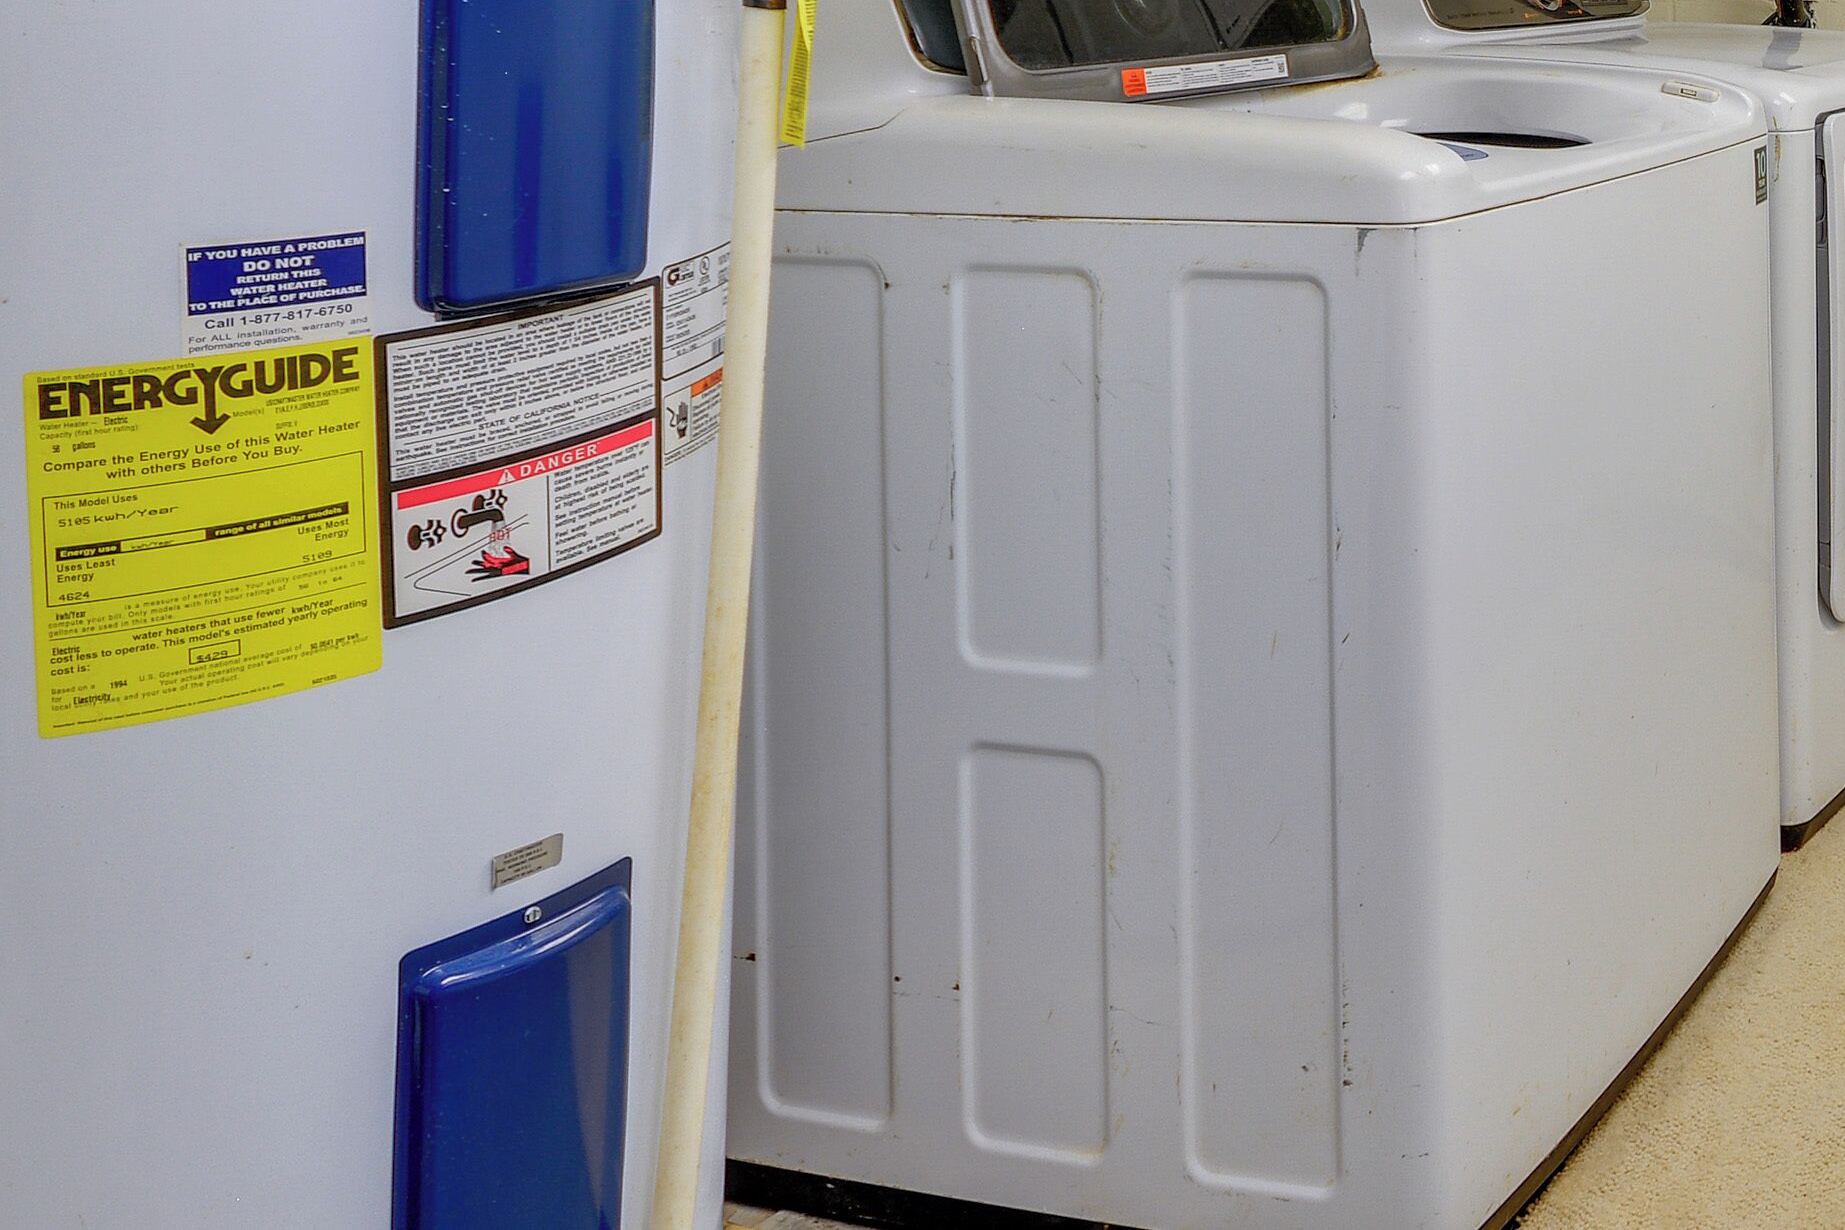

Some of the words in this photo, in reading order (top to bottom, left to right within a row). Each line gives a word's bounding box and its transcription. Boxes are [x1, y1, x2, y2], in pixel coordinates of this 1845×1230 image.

[188, 251, 202, 261] IF
[204, 248, 238, 260] YOU
[240, 244, 281, 257] HAVE
[284, 243, 296, 253] A
[297, 235, 364, 251] PROBLEM
[242, 259, 270, 272] DO
[274, 254, 314, 269] NOT
[236, 271, 288, 284] RETURN
[290, 267, 321, 278] THIS
[229, 283, 276, 296] WATER
[277, 278, 328, 291] HEATER
[188, 302, 206, 311] TO
[208, 299, 235, 309] THE
[236, 295, 278, 306] PLACE
[279, 292, 297, 302] OF
[298, 284, 365, 300] PURCHASE.
[204, 317, 234, 329] Call
[240, 302, 352, 325] 1-877-817-6750
[518, 314, 563, 330] IMPORTANT
[188, 335, 205, 343] For
[210, 333, 231, 341] ALL
[302, 319, 344, 332] warranty
[350, 315, 368, 324] and
[188, 339, 251, 353] performance
[253, 333, 302, 346] questions.
[37, 375, 60, 383] Based
[74, 371, 106, 380] standard
[128, 364, 175, 374] Government
[176, 362, 194, 370] tests
[38, 346, 360, 422] ENERGYGUIDE
[478, 418, 505, 430] STATE
[509, 414, 519, 423] OF
[524, 401, 570, 419] CALIFORNIA
[573, 393, 599, 406] NOTICE
[40, 422, 61, 430] Water
[64, 420, 88, 428] Heater
[40, 430, 72, 441] Capacity
[74, 428, 92, 437] (first
[113, 424, 138, 433] rating)
[43, 456, 106, 474] Compare
[112, 453, 134, 464] the
[140, 446, 189, 463] Energy
[195, 442, 221, 454] Use
[226, 439, 241, 450] of
[245, 435, 270, 447] this
[275, 428, 313, 443] Water
[318, 419, 360, 435] Heater
[72, 441, 96, 451] gallons
[106, 466, 135, 479] with
[141, 460, 186, 475] others
[191, 453, 237, 468] Before
[242, 448, 268, 461] You
[274, 442, 302, 457] Buy.
[520, 441, 596, 478] DANGER
[54, 499, 75, 510] This
[78, 496, 108, 507] Model
[112, 492, 138, 503] Uses
[94, 504, 180, 523] kwh/Year
[214, 525, 244, 537] range
[246, 522, 257, 531] of
[259, 520, 271, 529] all
[272, 513, 306, 526] similar
[307, 505, 342, 519] models
[297, 523, 321, 535] Uses
[325, 517, 348, 529] Most
[315, 526, 348, 542] Energy
[60, 547, 96, 558] Energy
[98, 545, 116, 553] use
[56, 562, 82, 572] Uses
[86, 558, 115, 569] Least
[56, 571, 94, 585] Energy
[58, 590, 90, 602] 4624
[132, 629, 161, 641] water
[166, 621, 206, 636] heaters
[209, 617, 231, 628] that
[234, 614, 252, 623] use
[256, 606, 285, 619] fewer
[291, 597, 333, 614] kwh/Year
[50, 653, 72, 664] cost
[76, 650, 97, 660] less
[101, 648, 111, 657] to
[115, 641, 159, 657] operate.
[162, 636, 185, 648] This
[188, 628, 230, 643] model's
[233, 616, 284, 634] estimated
[288, 609, 317, 625] yearly
[321, 597, 367, 617] operating
[52, 644, 80, 656] Electric
[50, 666, 74, 676] cost
[77, 663, 90, 673] is:
